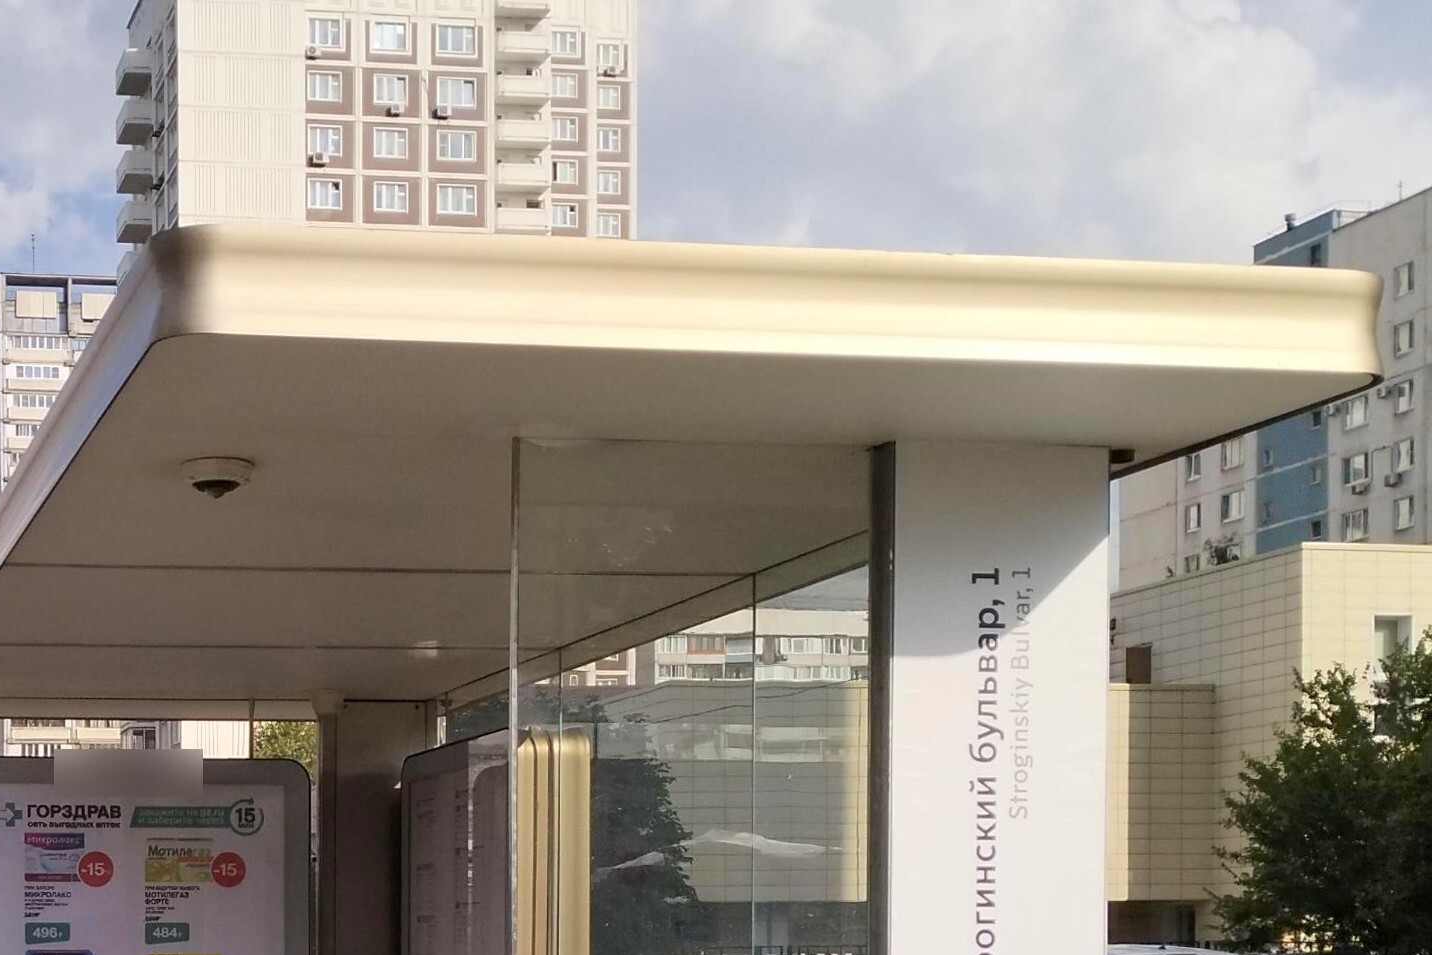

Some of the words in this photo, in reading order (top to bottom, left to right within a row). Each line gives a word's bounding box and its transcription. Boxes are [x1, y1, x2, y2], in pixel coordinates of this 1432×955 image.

[972, 568, 999, 585] 1
[1012, 567, 1030, 578] 1
[1010, 588, 1033, 669] Bulvar,
[969, 599, 1005, 762] бульвар,
[1009, 678, 1033, 819] Stroginskiy
[27, 804, 121, 820] ГОРЗДРАВ
[235, 807, 256, 824] 15
